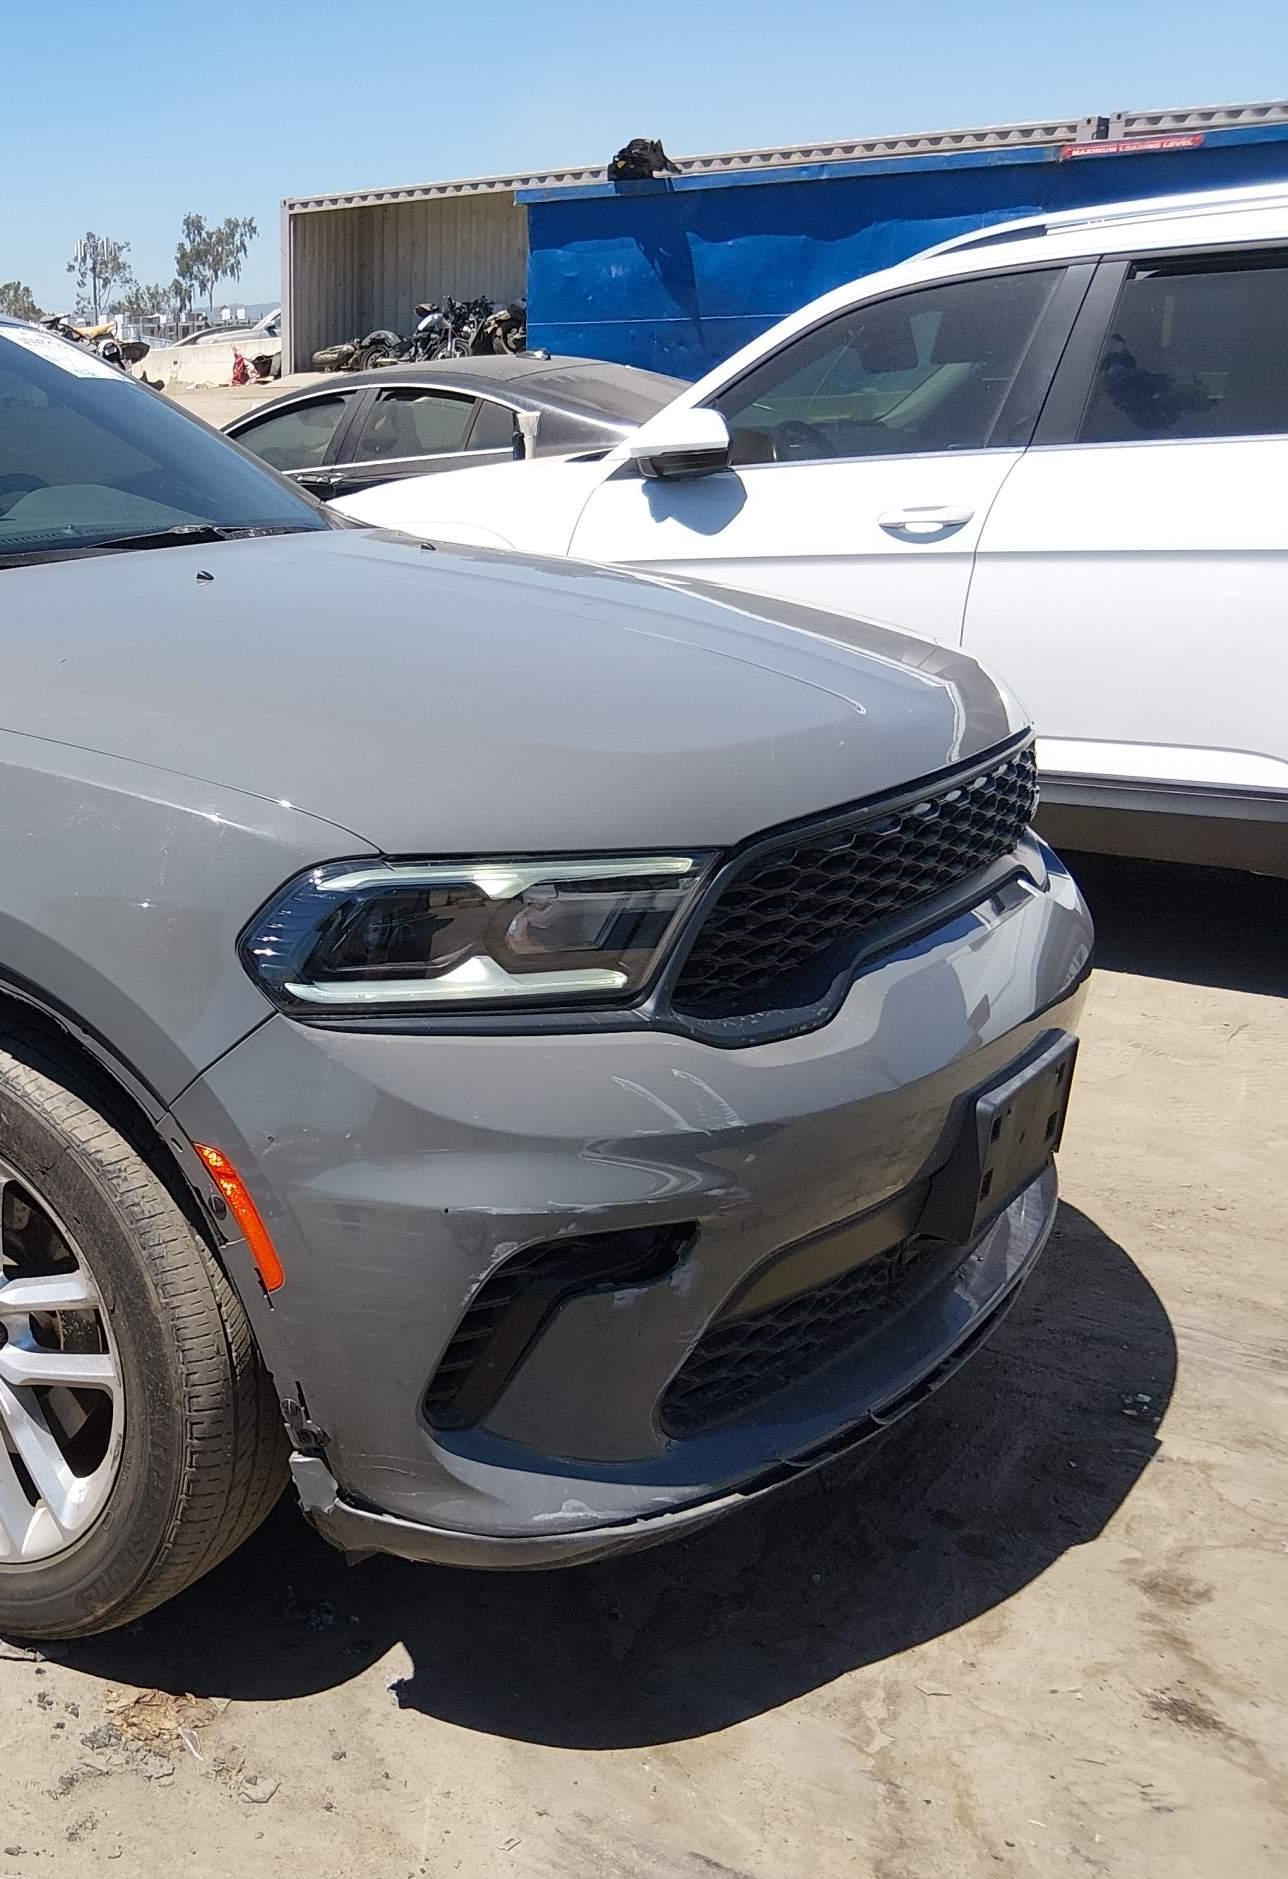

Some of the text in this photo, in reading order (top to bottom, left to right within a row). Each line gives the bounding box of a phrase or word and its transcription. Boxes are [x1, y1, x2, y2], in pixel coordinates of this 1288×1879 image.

[1071, 140, 1193, 156] MAXIMUM LOADING LEVEL
